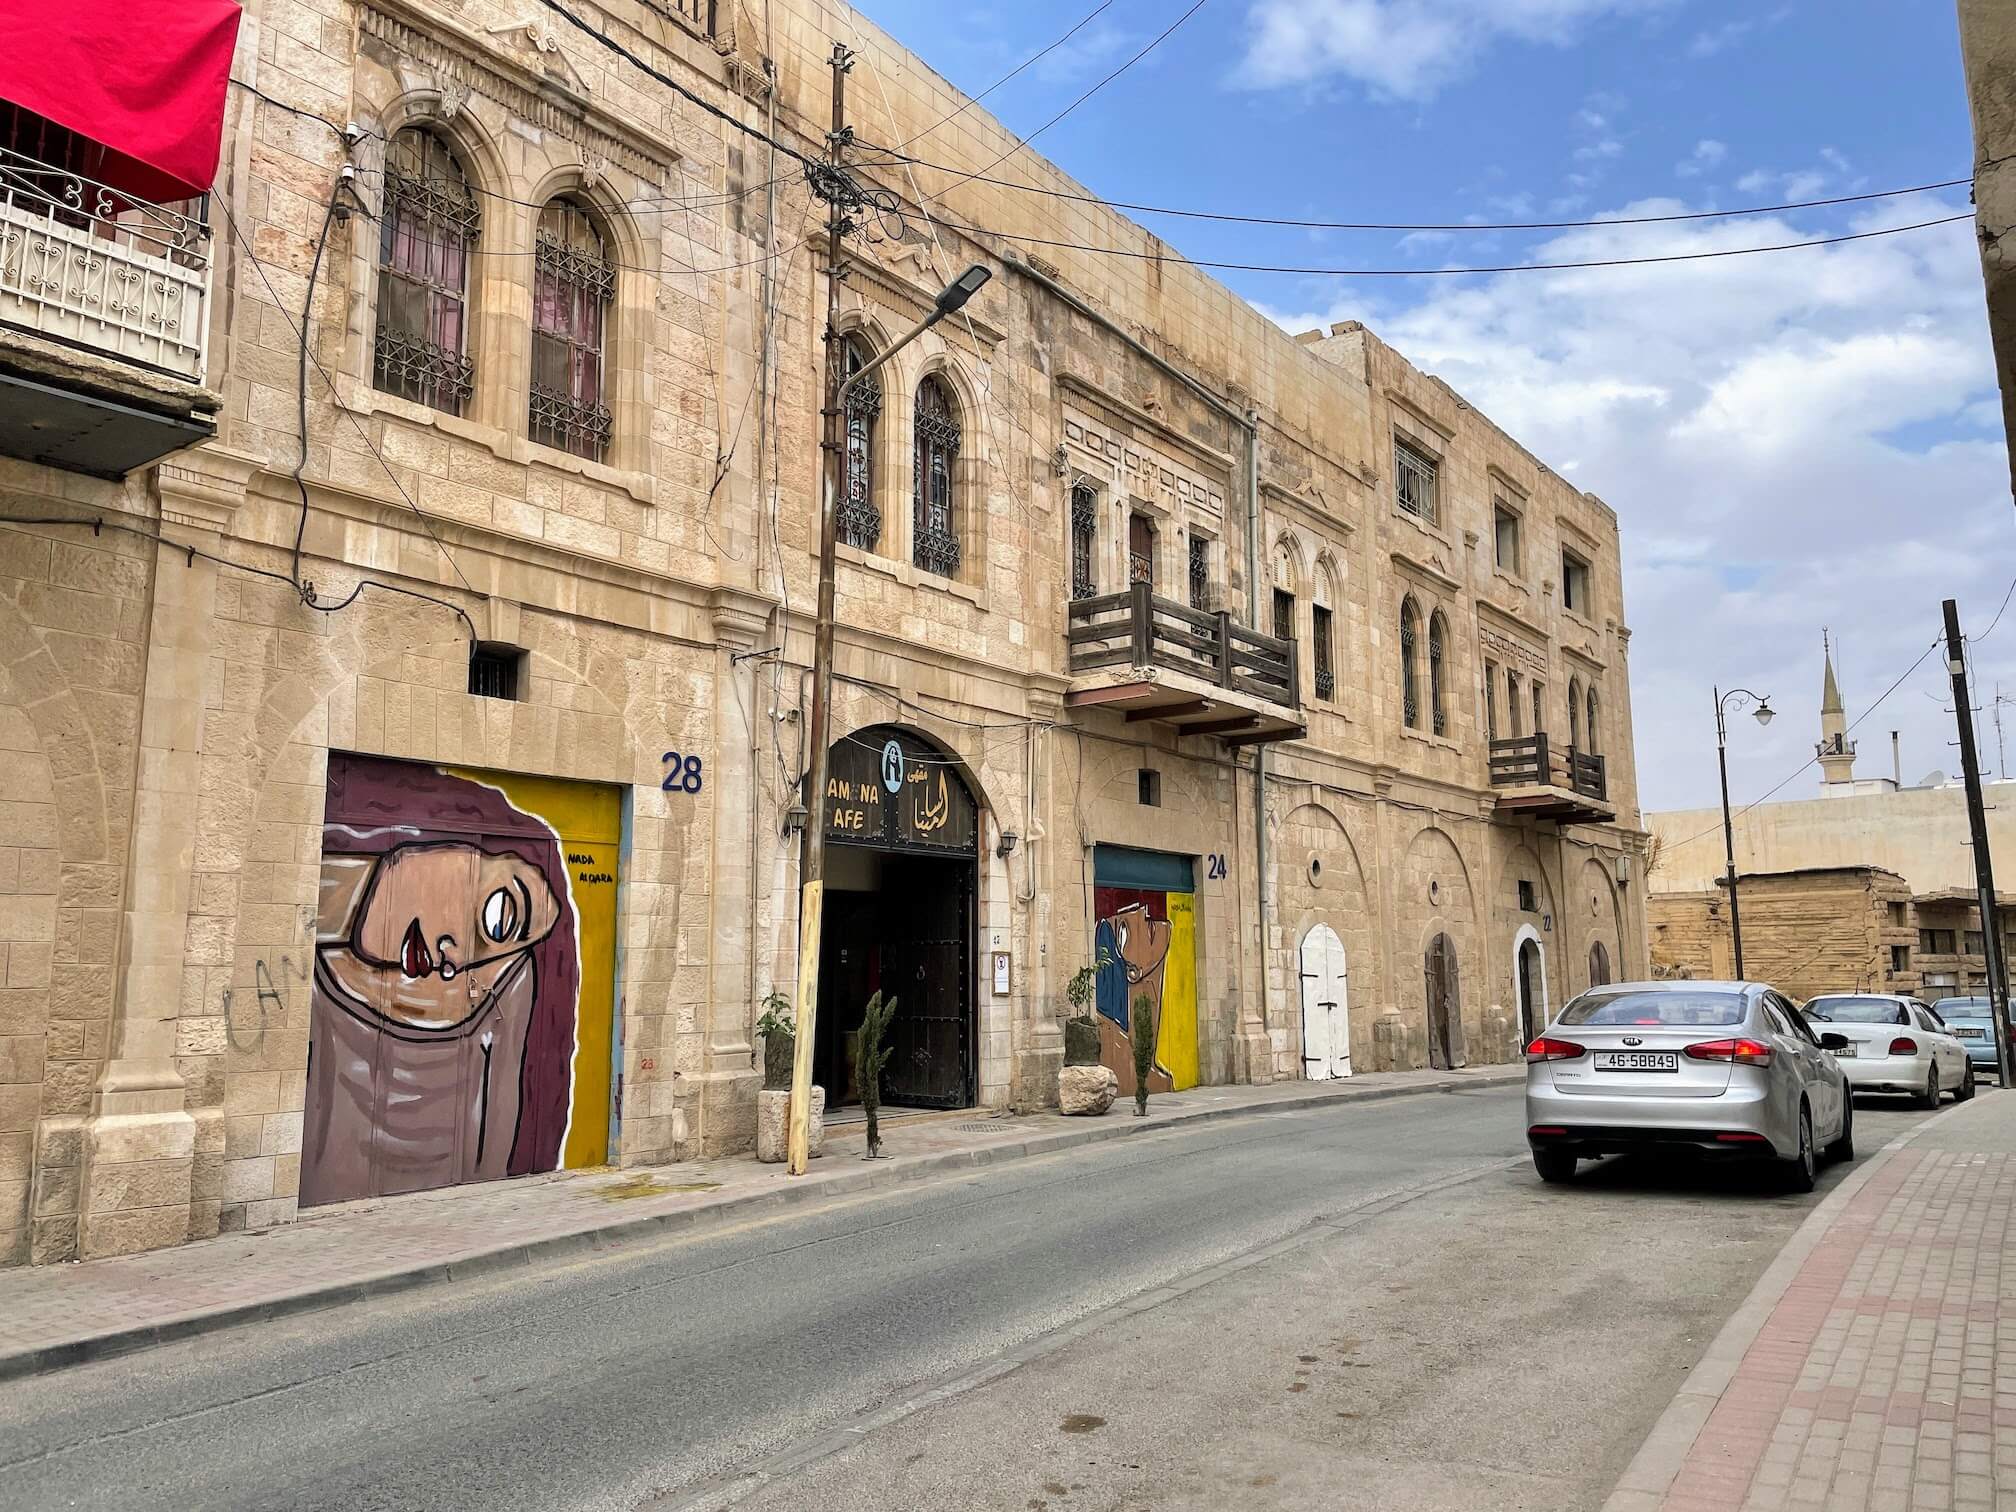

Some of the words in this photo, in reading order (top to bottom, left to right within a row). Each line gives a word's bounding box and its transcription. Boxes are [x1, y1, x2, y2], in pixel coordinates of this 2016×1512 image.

[661, 752, 702, 793] 28
[827, 777, 879, 804] AMNA
[568, 853, 595, 865] NADA
[1207, 854, 1227, 880] 24
[1623, 1037, 1641, 1045] KIA
